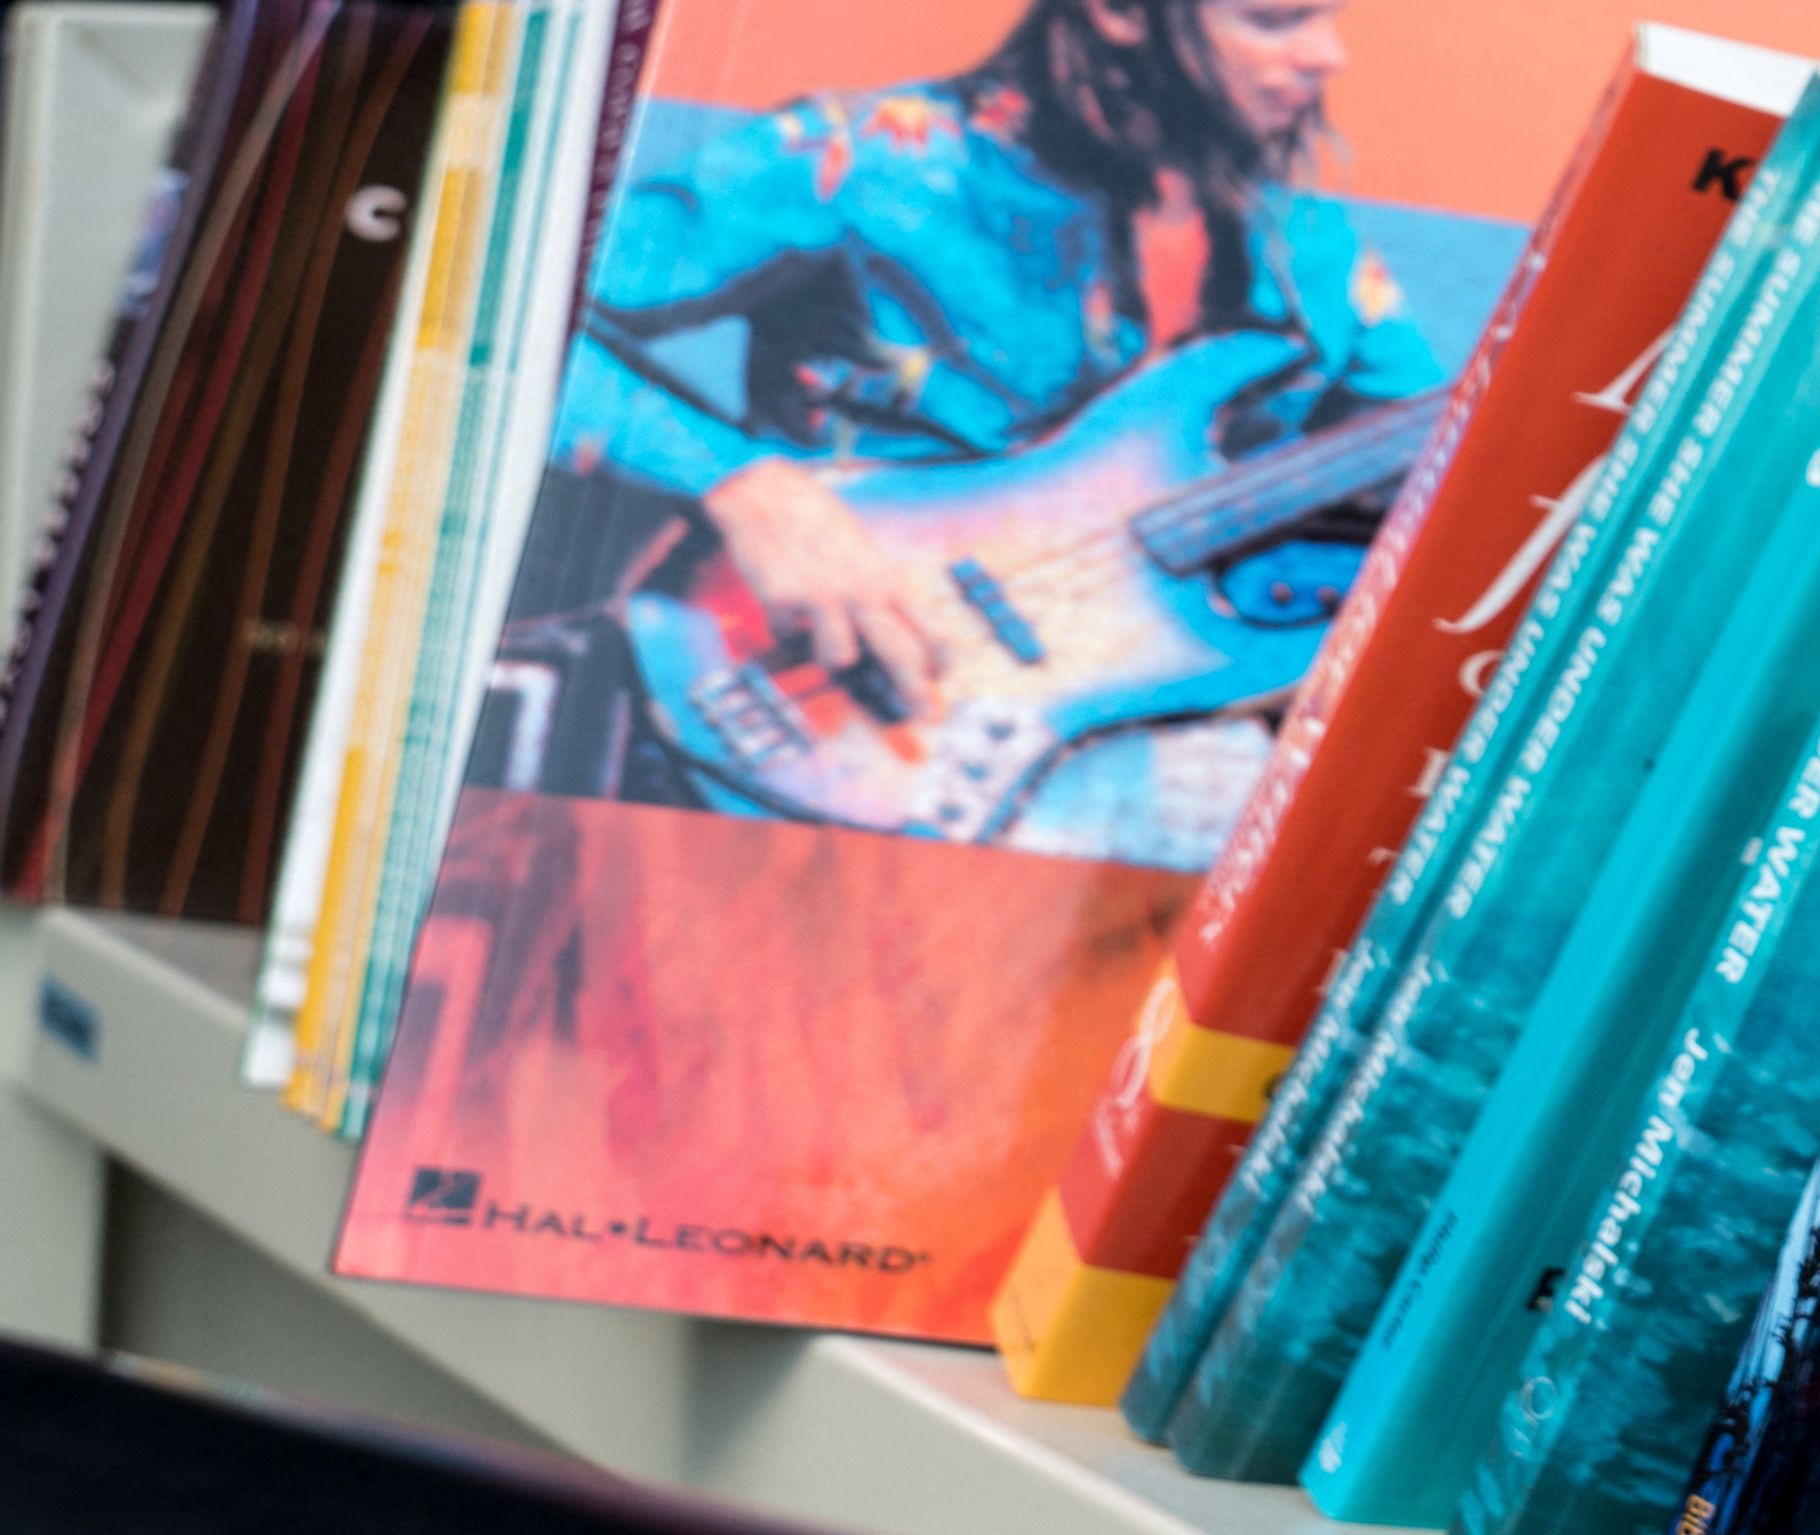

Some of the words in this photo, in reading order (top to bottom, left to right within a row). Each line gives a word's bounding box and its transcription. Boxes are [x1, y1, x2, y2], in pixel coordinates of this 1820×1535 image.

[1626, 247, 1740, 436] SUMMER
[1690, 244, 1807, 437] SUMMER
[1582, 432, 1644, 522] SHE
[1643, 436, 1707, 527] SHE
[1530, 519, 1598, 622] WAS
[1592, 523, 1662, 627] WAS
[1456, 617, 1548, 765] UNDER
[1519, 624, 1610, 768] UNDER
[1382, 763, 1472, 906] WATER
[1439, 772, 1533, 920] WATER
[1712, 820, 1807, 985] WATER
[1655, 1026, 1717, 1111] Jen
[1559, 1111, 1680, 1325] Michalski
